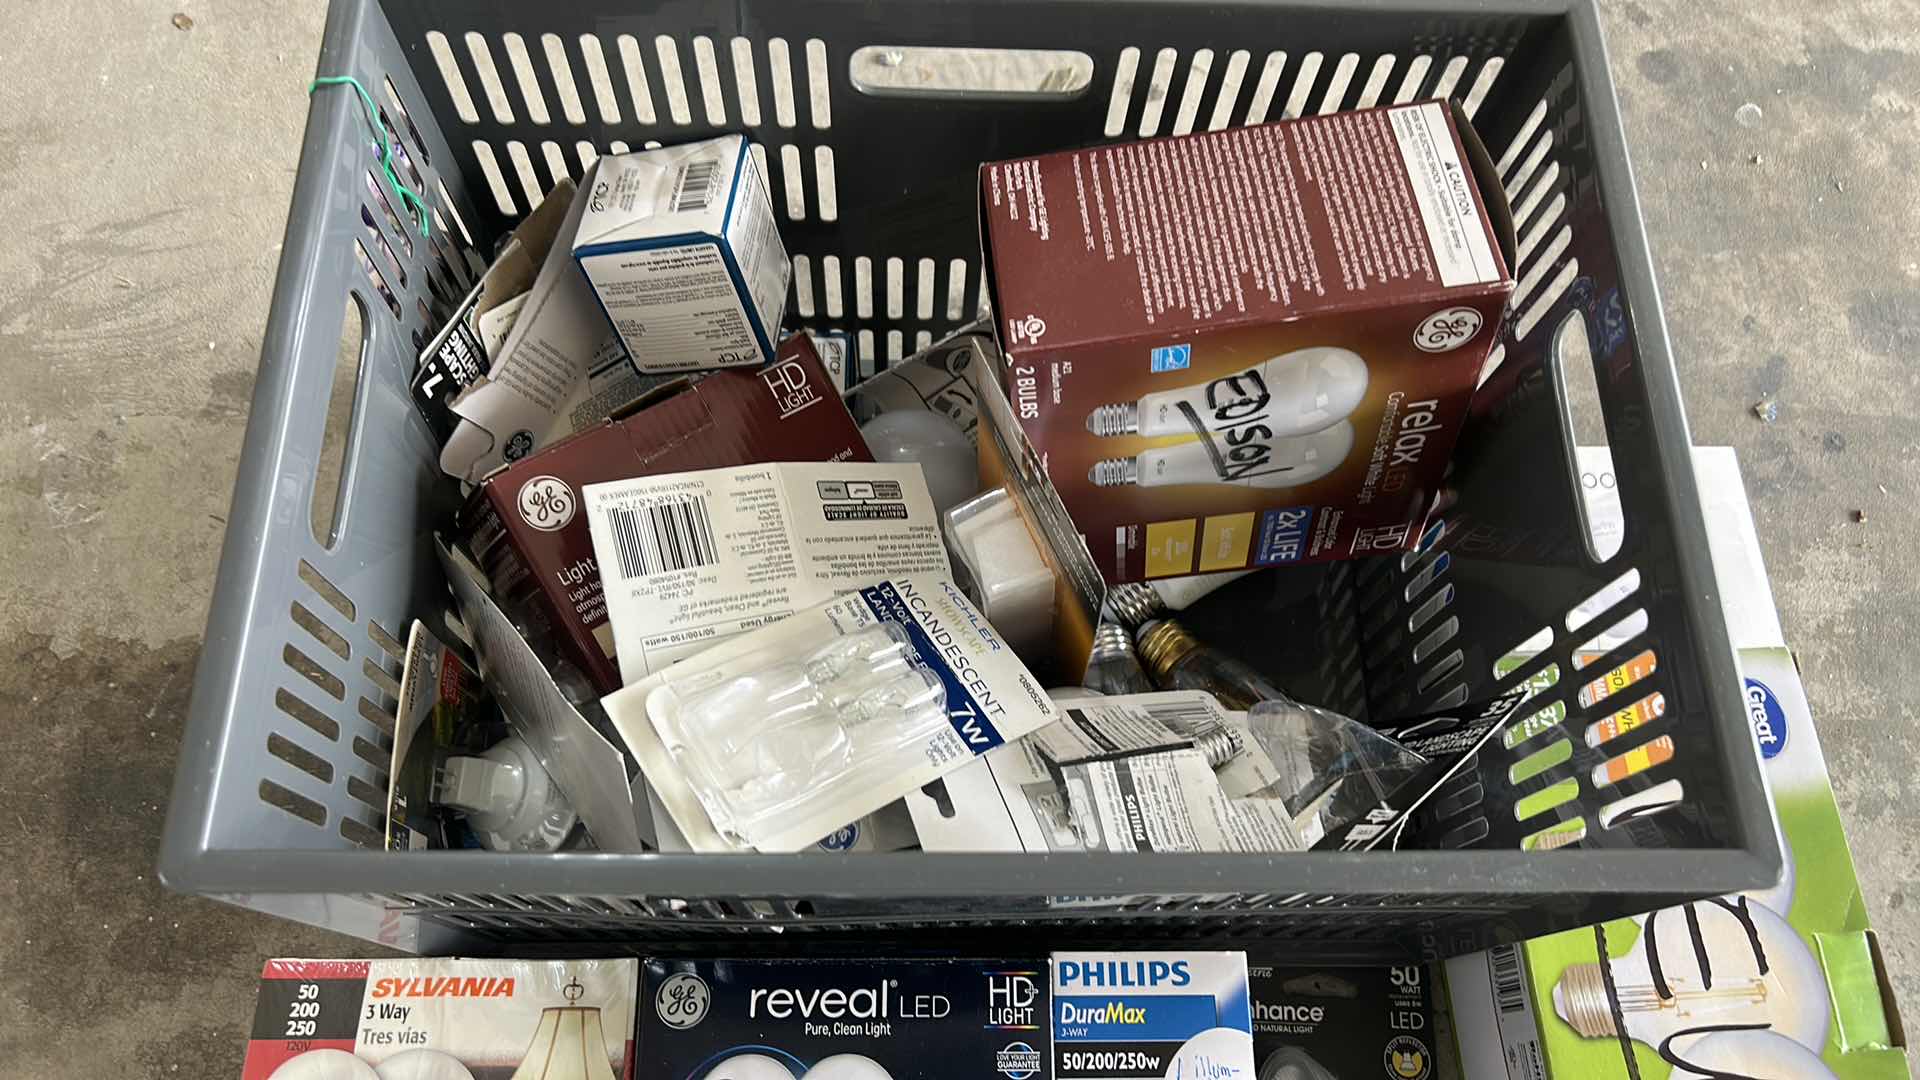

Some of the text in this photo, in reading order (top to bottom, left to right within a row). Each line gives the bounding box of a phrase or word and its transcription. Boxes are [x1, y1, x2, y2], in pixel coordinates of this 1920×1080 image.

[1448, 171, 1472, 216] CAUTION
[439, 342, 467, 386] SCAPE
[448, 330, 480, 381] GHTING
[717, 351, 740, 363] TCP
[763, 362, 807, 400] HD
[1016, 366, 1035, 376] 2
[777, 384, 815, 413] LIGHT
[1018, 378, 1039, 419] BULBS
[1206, 369, 1293, 481] EDISON
[1390, 399, 1442, 466] relax
[1270, 531, 1303, 561] LIFE
[881, 586, 912, 626] 12-Volt
[938, 581, 1001, 651] KICHLER
[670, 626, 715, 643] 50/100/150
[739, 618, 761, 629] Used
[644, 636, 668, 646] watts
[896, 579, 1006, 716] INCANDESCENT
[1746, 683, 1778, 746] Great
[1125, 794, 1145, 842] PHILIPS
[1059, 961, 1191, 987] PHILIPS
[298, 984, 319, 999] 50
[371, 977, 515, 999] SYLVANIA
[1401, 986, 1421, 994] WATT
[289, 1002, 320, 1018] 200
[366, 1003, 411, 1024] 3 Way
[901, 995, 950, 1018] LED
[989, 1007, 1034, 1025] LIGHT
[1061, 1002, 1145, 1025] DuraMax
[1250, 1000, 1325, 1022] hance
[285, 1020, 316, 1036] 250
[805, 1021, 892, 1038] Pure, Clean Light
[1260, 1024, 1313, 1034] NATURAL LIGHT
[1391, 1012, 1424, 1030] LED
[362, 1026, 427, 1045] Tres vías
[1061, 1028, 1088, 1037] 3-WAY
[997, 1061, 1040, 1069] GUARANTEE
[1062, 1052, 1160, 1071] 50/200/250w
